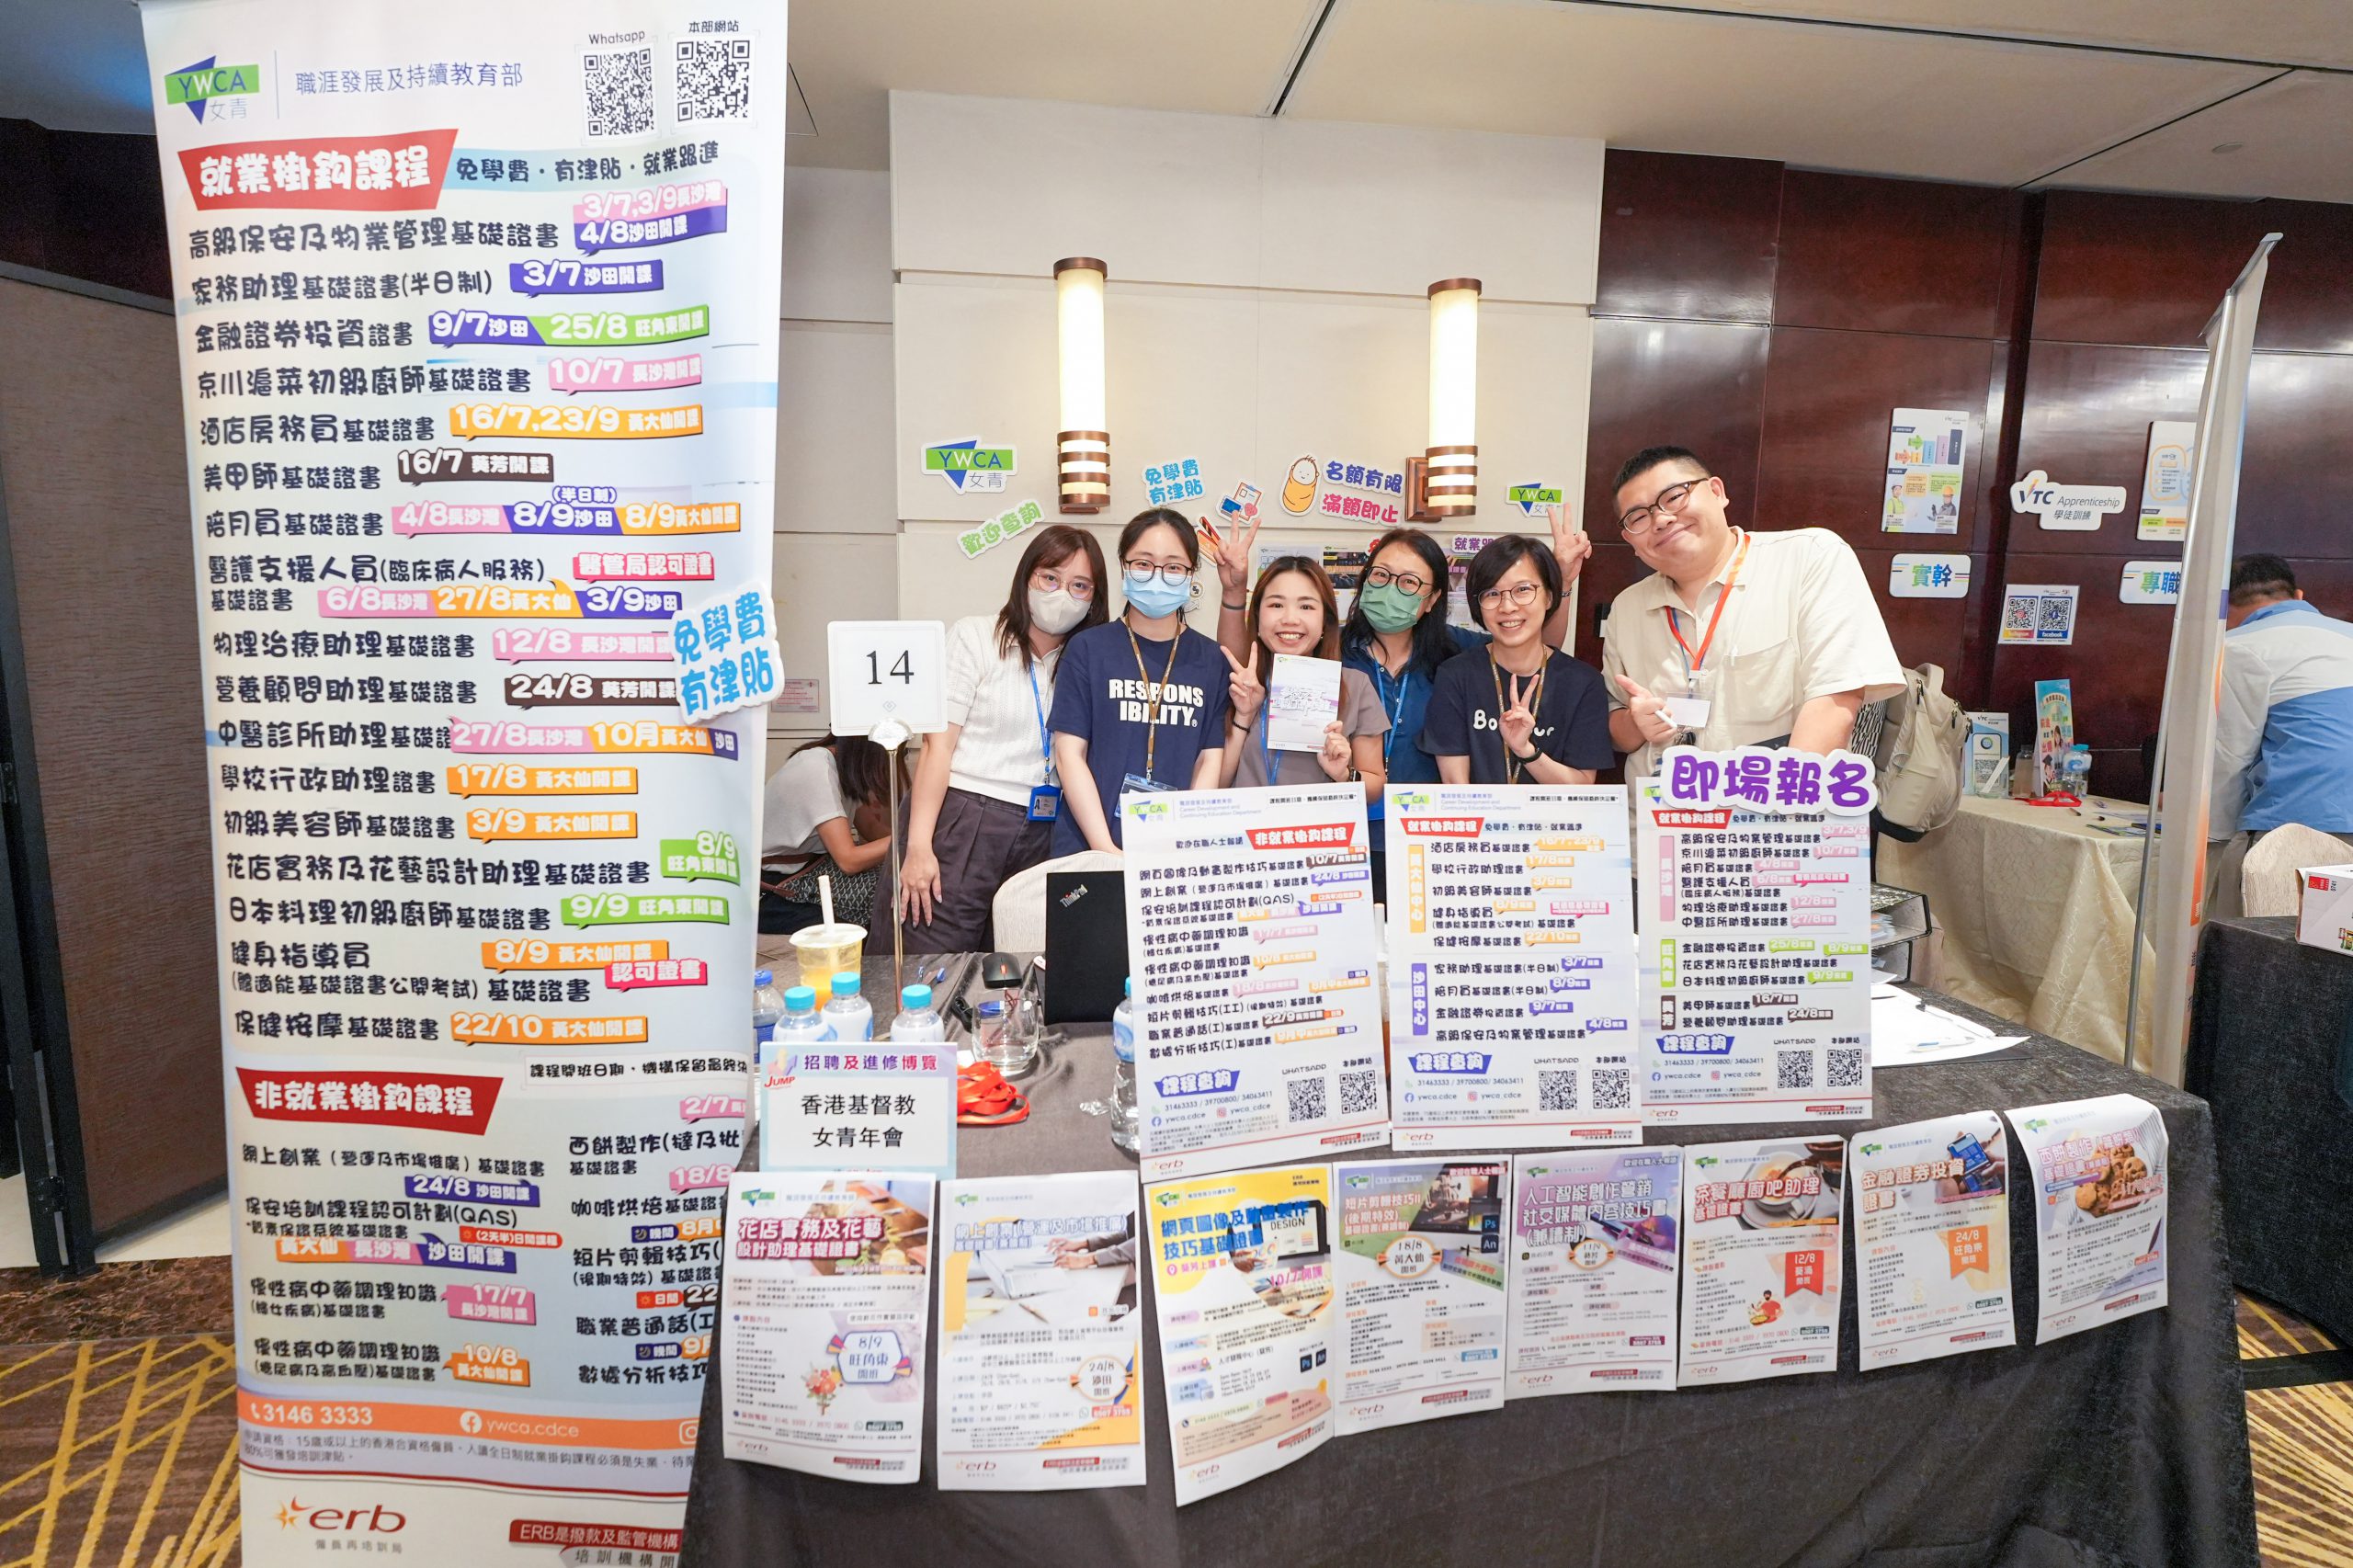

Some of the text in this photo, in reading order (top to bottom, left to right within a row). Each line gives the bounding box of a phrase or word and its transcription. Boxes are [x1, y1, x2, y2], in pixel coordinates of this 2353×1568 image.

[588, 29, 646, 45] Whatsapp
[688, 20, 740, 33] 本部網站
[178, 69, 247, 98] YWCA
[295, 62, 523, 95] 職涯發展及持續教育部
[210, 98, 247, 121] 女青
[189, 217, 559, 259] 高級保安及物業管理基礎證書
[192, 269, 493, 306] 家務助理基礎證書(半日制)
[195, 319, 413, 353] 金融證券投資證書
[198, 366, 531, 399] 京川滬菜初級廚師基礎證書
[200, 414, 435, 446] 酒店房務員基礎證書
[939, 451, 1003, 468] YWCA
[1145, 459, 1199, 485] 免學費
[204, 461, 381, 492] 美甲師基礎證書
[969, 472, 1004, 489] 女青
[1325, 460, 1404, 494] 名額有限
[552, 487, 617, 503] (半日制)
[1149, 478, 1204, 506] 有津貼
[1518, 489, 1555, 502] YWCA
[2019, 480, 2120, 509] VTC Apprenticeship
[1322, 493, 1400, 525] 滿額即止
[2053, 509, 2092, 521] 學徒訓練
[206, 508, 383, 538] 陪月員基礎證書
[961, 501, 1044, 555] 歡迎查詢
[210, 554, 544, 584] 醫護支援人員(臨床病人服務)
[578, 553, 713, 577] 醫管局認可證書
[1911, 562, 1953, 589] 實幹
[211, 587, 292, 612] 基礎證書
[674, 591, 766, 665] 免學費
[213, 630, 474, 659] 物理治療助理基礎證書
[680, 647, 774, 715] 有津貼
[865, 649, 915, 687] 14
[216, 675, 477, 704] 營養顧問助理基礎證書
[222, 764, 436, 794] 學校行政助理證書
[1671, 755, 1870, 808] 即場報名
[223, 810, 455, 839] 初級美容師基礎證書
[696, 831, 735, 857] 8/9
[227, 853, 651, 887] 花店實務及花藝設計助理基礎證書
[1059, 883, 1088, 908] ThinkPad
[230, 896, 551, 931] 日本料理初級廚師基礎證書
[231, 939, 371, 970] 健身指導員
[611, 959, 701, 983] 認可證書
[488, 978, 592, 1003] 基礎證書
[235, 1009, 440, 1041] 保健按摩基礎證書
[804, 1054, 938, 1071] 招聘及進修博覽
[764, 1075, 796, 1088] JUMP
[801, 1094, 916, 1116] 香港基督教
[813, 1126, 904, 1149] 女青年會
[570, 1160, 638, 1176] 基礎證書
[572, 1196, 723, 1218] 咖啡烘焙基礎證
[739, 1217, 883, 1241] 花店實務及花藝
[1270, 1217, 1306, 1231] DESIGN
[250, 1277, 438, 1303] 慢性病中藥調理知識
[472, 1282, 528, 1305] 17/7
[254, 1337, 441, 1363] 慢性病中藥調理知識
[462, 1343, 519, 1366] 10/8
[262, 1403, 374, 1426] 3146 3333
[485, 1418, 580, 1438] ywca.cdce
[309, 1504, 407, 1534] erb
